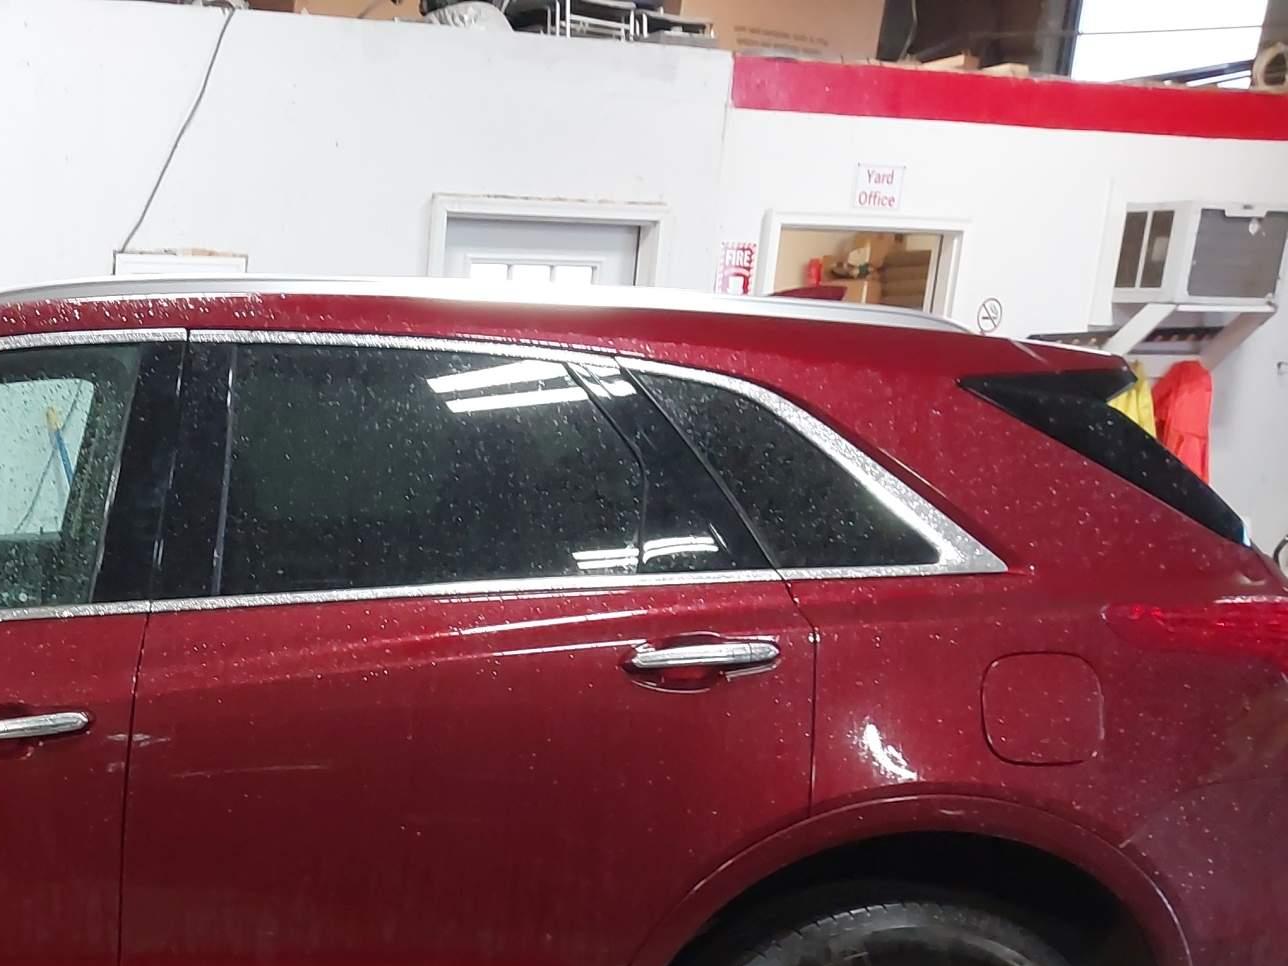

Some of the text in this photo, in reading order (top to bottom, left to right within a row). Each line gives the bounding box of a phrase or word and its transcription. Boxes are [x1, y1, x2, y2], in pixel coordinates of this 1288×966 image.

[867, 169, 895, 185] Yard
[858, 190, 896, 207] Office
[725, 249, 752, 268] FIRE
